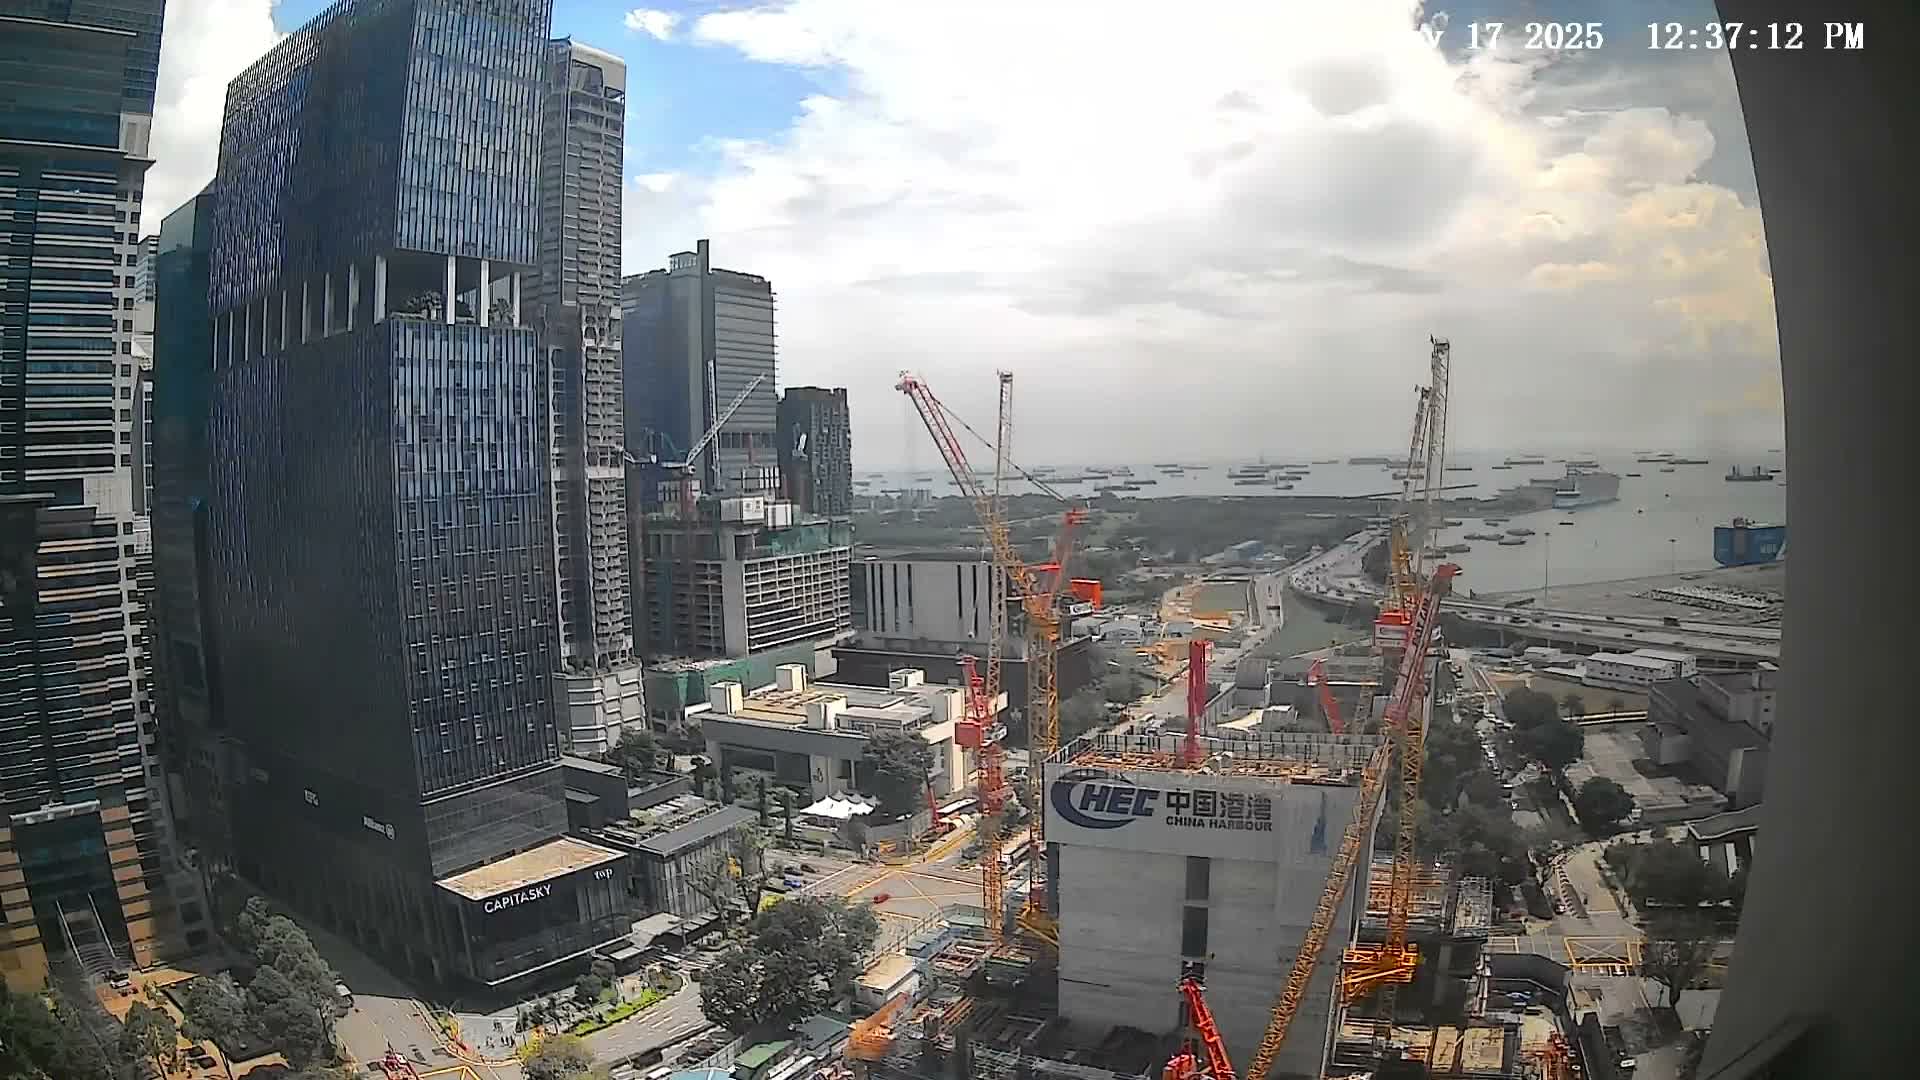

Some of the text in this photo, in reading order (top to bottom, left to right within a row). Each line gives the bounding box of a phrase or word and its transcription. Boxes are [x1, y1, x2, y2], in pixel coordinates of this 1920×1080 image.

[1166, 816, 1273, 832] CHINA HARBOUR
[484, 884, 552, 913] CAPITASKY
